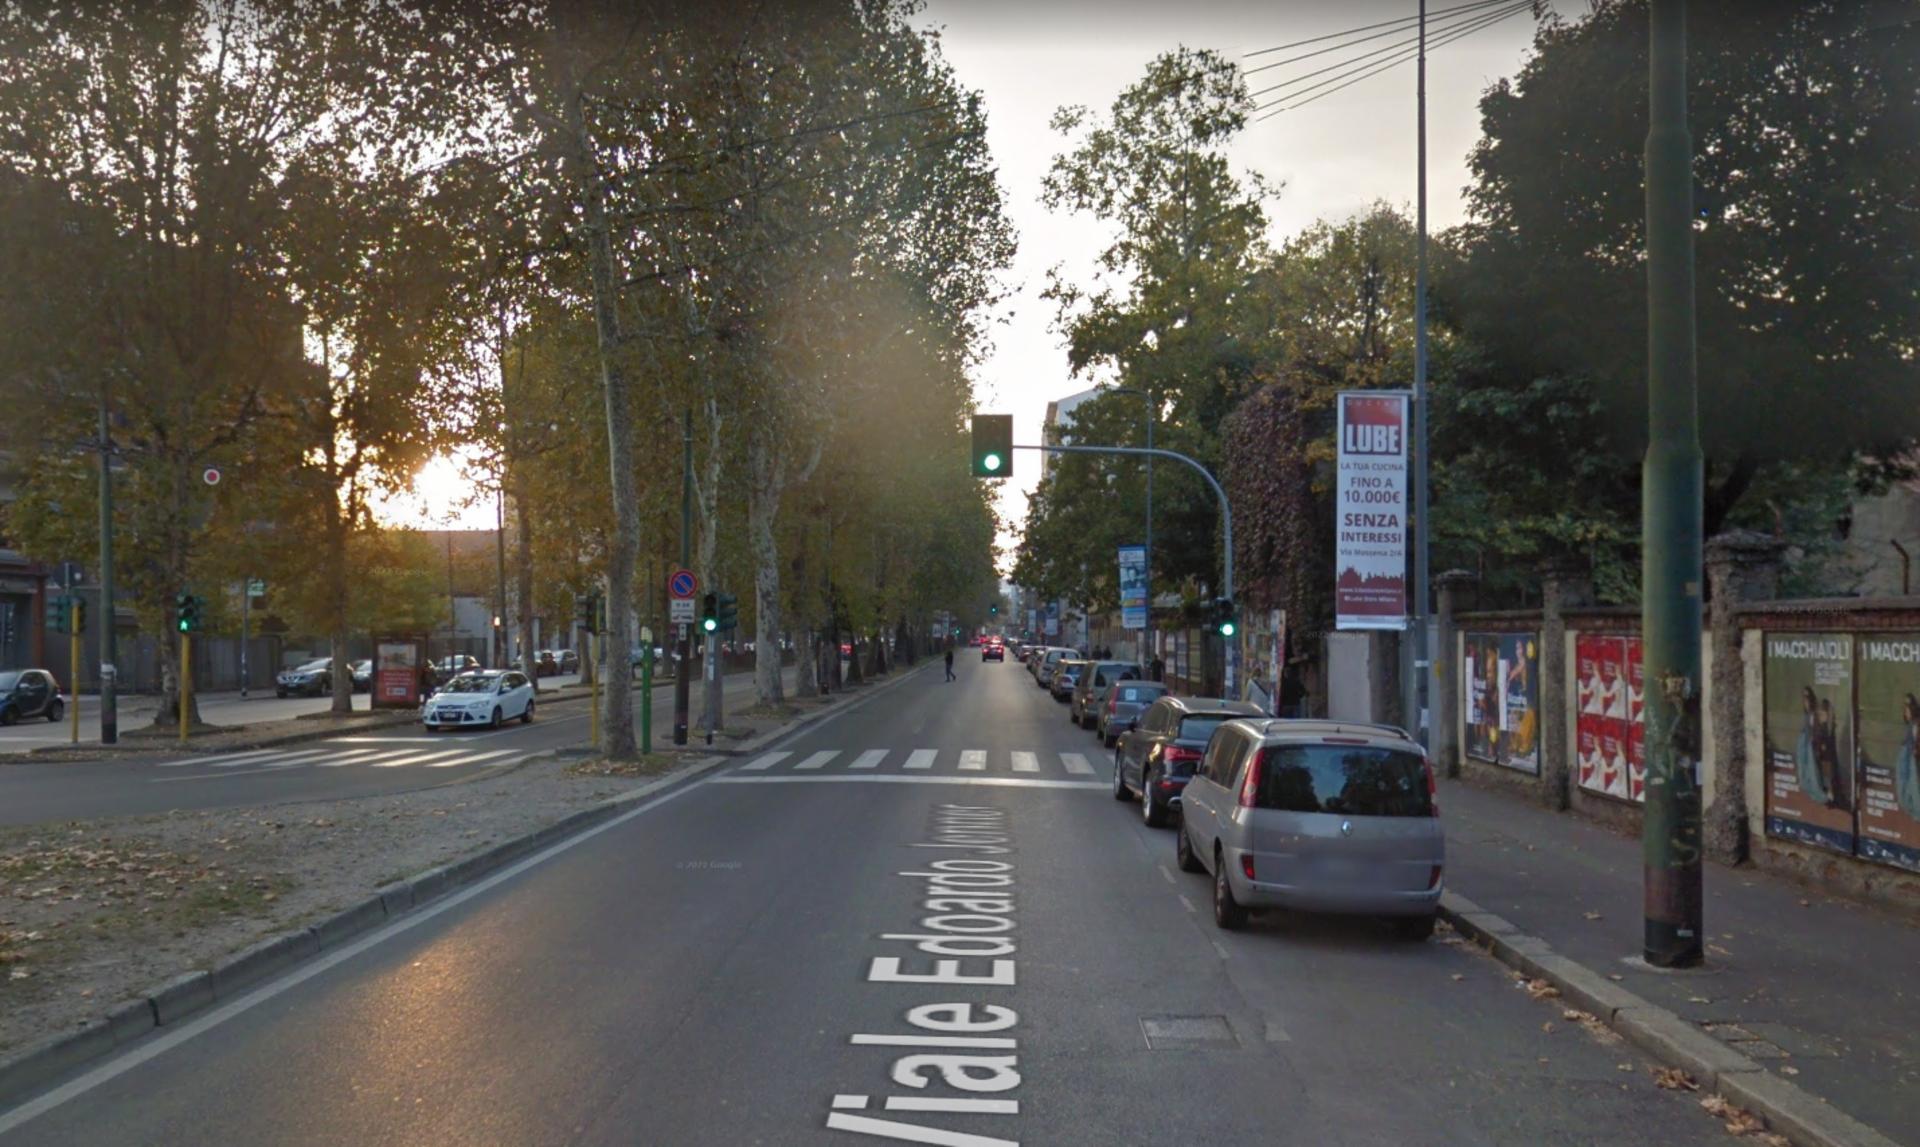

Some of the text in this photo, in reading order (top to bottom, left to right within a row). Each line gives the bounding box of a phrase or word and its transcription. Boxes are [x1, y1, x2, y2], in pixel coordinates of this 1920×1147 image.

[1346, 424, 1399, 453] LUBE
[1340, 462, 1351, 470] LA
[1371, 463, 1404, 471] CUCINA
[1351, 477, 1393, 488] FINO A
[1344, 490, 1400, 504] 10.000€
[1344, 513, 1399, 528] SENZA
[1341, 531, 1402, 544] INTERESSI
[1775, 641, 1849, 659] MACCHIAIOLI
